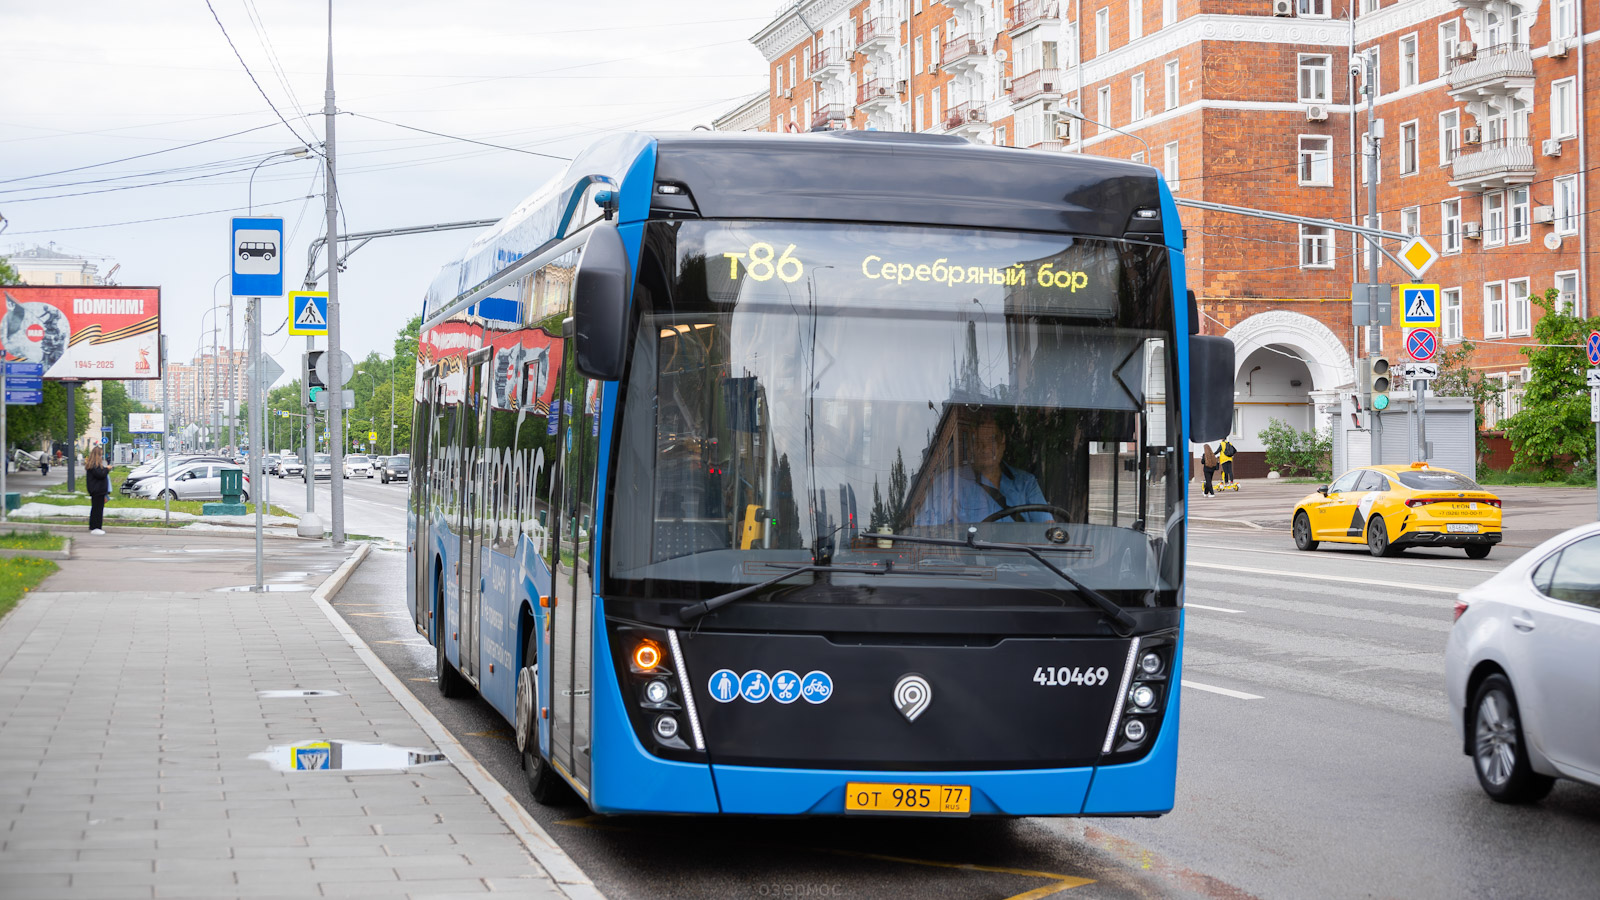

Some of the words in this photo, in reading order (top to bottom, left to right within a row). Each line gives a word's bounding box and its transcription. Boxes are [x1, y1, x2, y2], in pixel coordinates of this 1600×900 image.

[862, 255, 1026, 287] Серебряный
[1037, 263, 1088, 293] бор
[73, 299, 144, 314] ПОМНИМ!
[1033, 667, 1109, 686] 410469
[857, 791, 882, 807] ОТ
[892, 788, 931, 808] 985
[944, 788, 963, 803] 77
